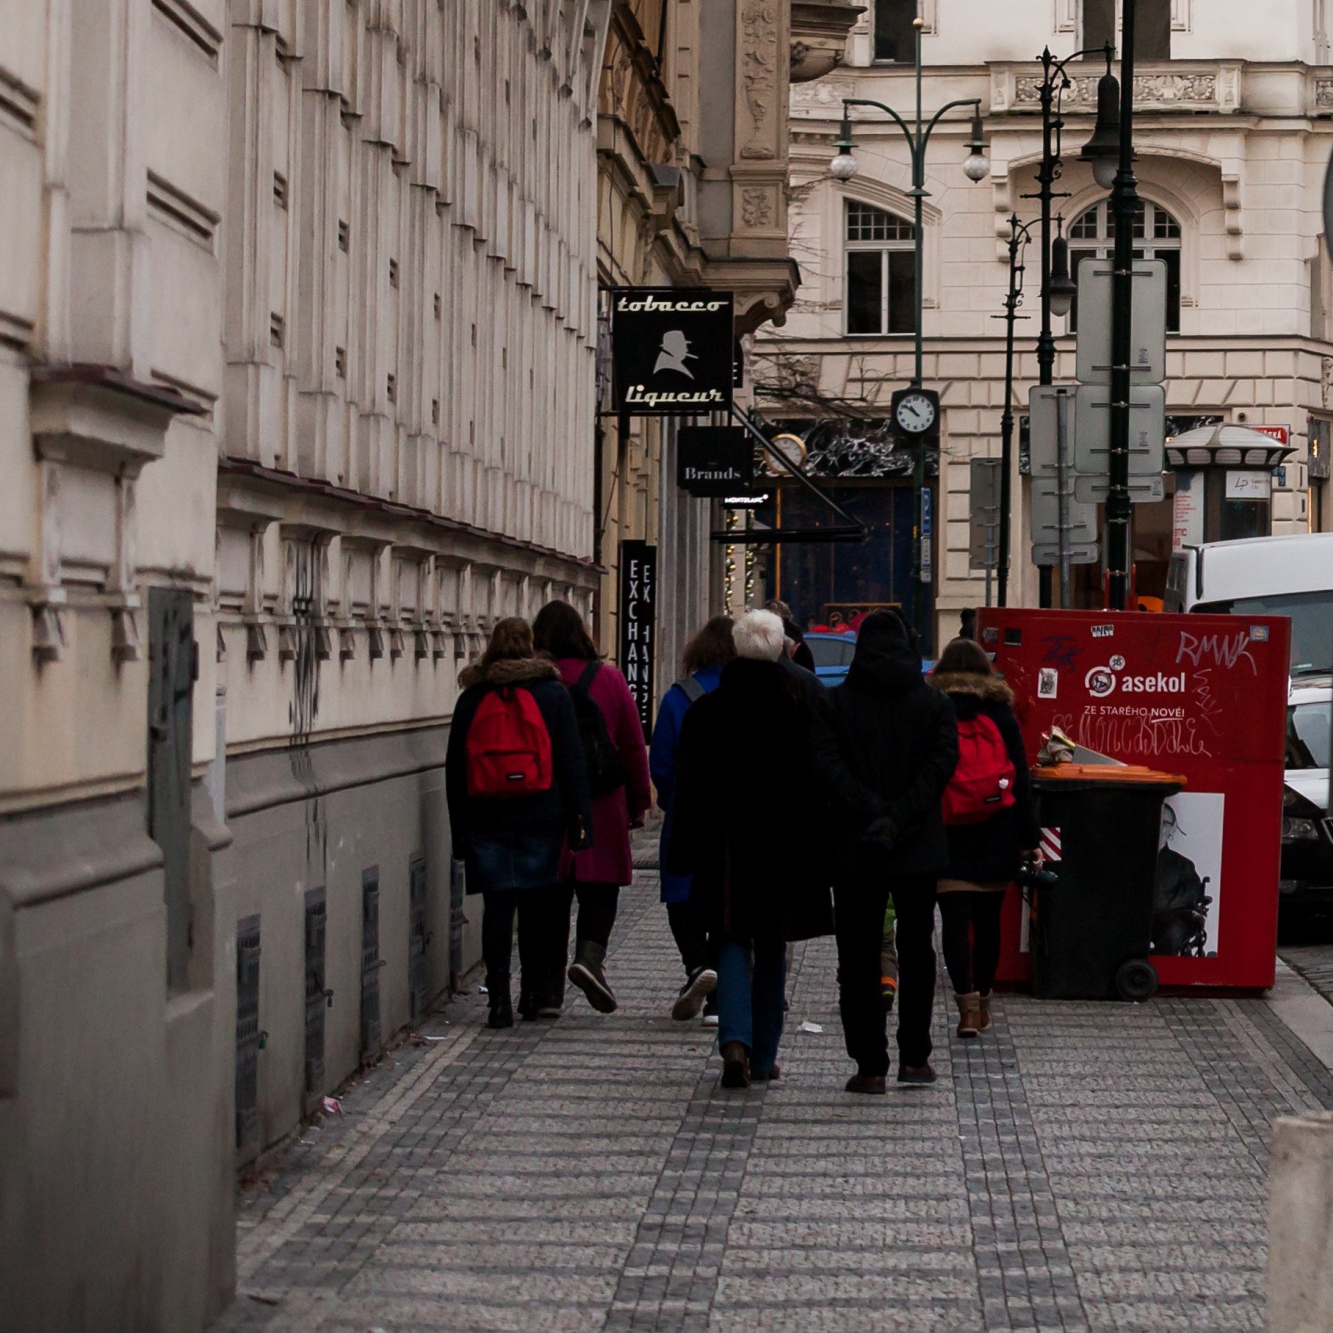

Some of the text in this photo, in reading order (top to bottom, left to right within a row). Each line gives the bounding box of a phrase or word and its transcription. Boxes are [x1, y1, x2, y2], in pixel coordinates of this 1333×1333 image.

[617, 295, 729, 312] tobacco
[625, 384, 725, 407] liqueur
[685, 467, 741, 480] Brands
[627, 559, 638, 701] EXCHANG
[1121, 671, 1186, 693] asekol
[1084, 704, 1185, 718] ZE STARÉHO NOVÉ!
